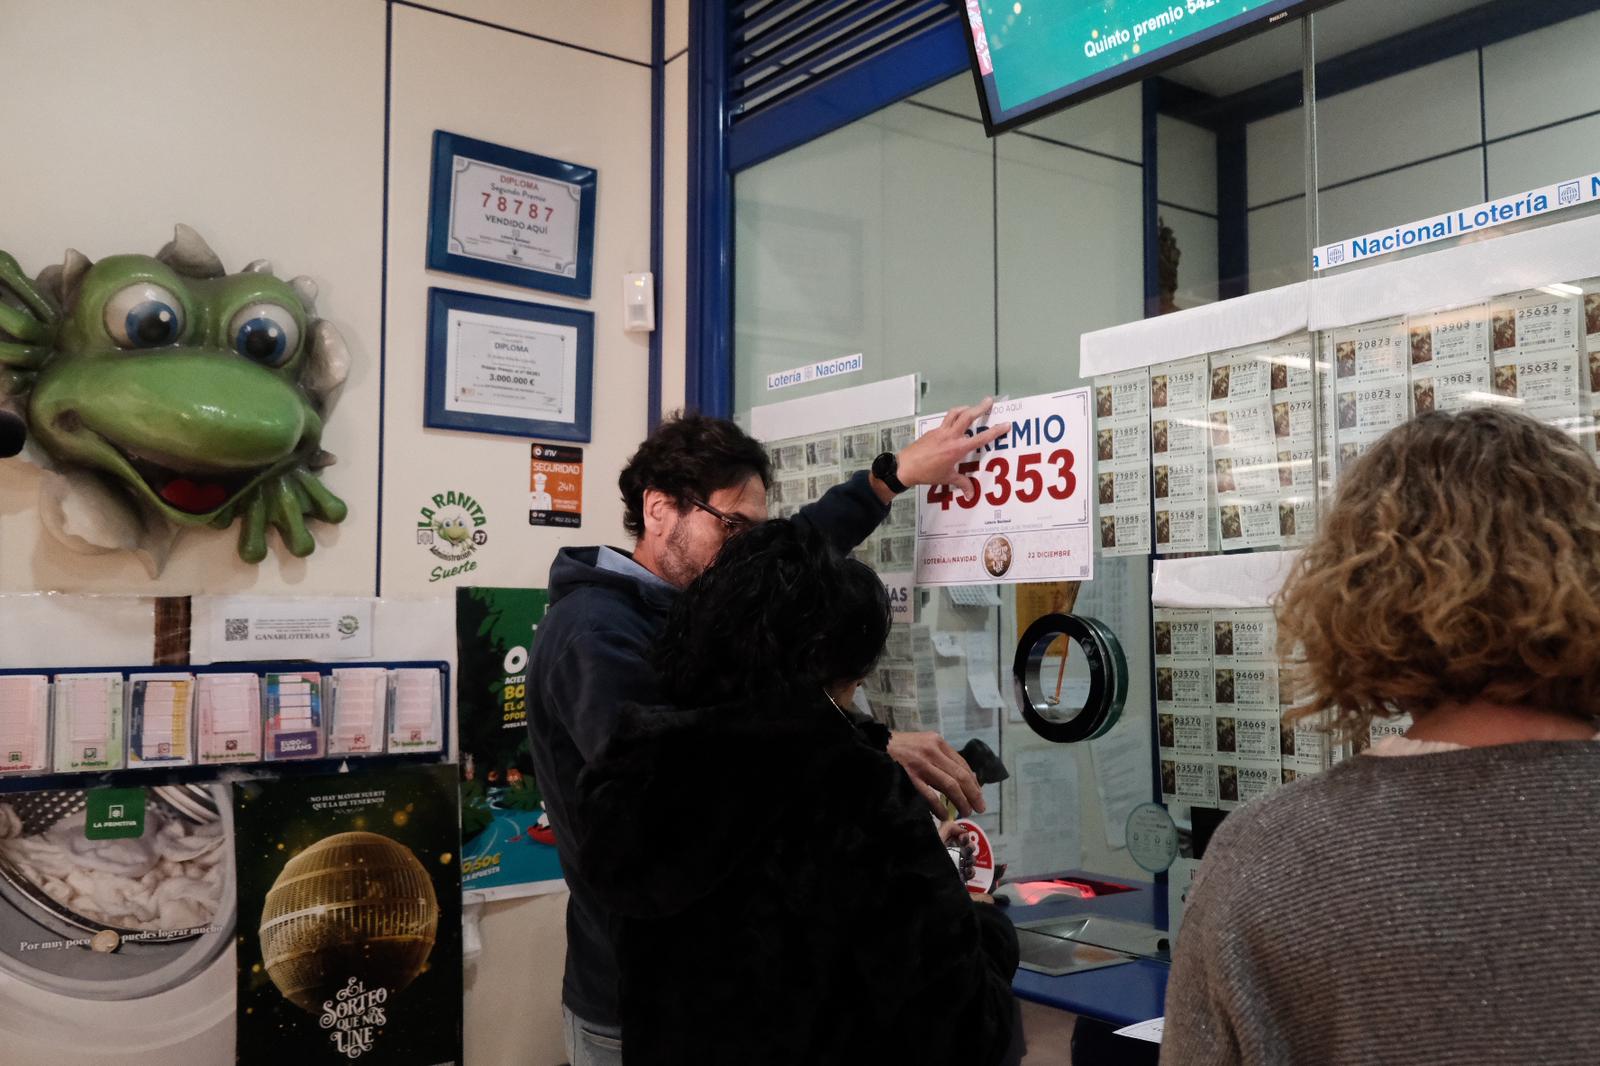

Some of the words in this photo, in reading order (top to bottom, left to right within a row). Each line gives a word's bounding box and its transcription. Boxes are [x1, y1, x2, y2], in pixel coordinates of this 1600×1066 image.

[1084, 26, 1130, 58] Quinto
[1132, 5, 1184, 40] premio
[491, 182, 520, 197] Segundo
[500, 175, 539, 191] DIPLOMA
[481, 192, 554, 222] 78787
[485, 214, 525, 230] VENDIDO
[1352, 216, 1452, 258] Nacional
[1458, 193, 1548, 231] Lotería
[1518, 305, 1558, 318] 25632
[494, 342, 529, 353] DIPLOMA
[1357, 338, 1390, 350] 20873
[768, 370, 801, 388] Lotería
[815, 355, 862, 377] Nacional
[1231, 362, 1258, 373] 11274
[1520, 361, 1558, 375] 25632
[489, 373, 528, 385] 3.000.000
[1358, 389, 1390, 401] 20873
[533, 461, 580, 475] SEGURIDAD
[926, 448, 1077, 511] 45353
[418, 507, 436, 528] LA
[431, 491, 487, 527] RANITA
[952, 555, 978, 564] NAVIDAD
[1036, 549, 1072, 558] DICIEMBRE
[429, 560, 477, 582] Suerte
[1172, 623, 1199, 631] 63570
[1173, 670, 1200, 678] 63570
[1236, 671, 1265, 680] 94669
[504, 684, 525, 700] BO
[1174, 717, 1201, 725] 63570
[1237, 720, 1266, 729] 94669
[1371, 726, 1404, 736] 97998
[1238, 769, 1268, 778] 94669
[361, 790, 386, 798] SUERTE
[312, 802, 327, 810] QUE
[121, 930, 156, 943] puedes
[158, 928, 189, 940] lograr
[20, 941, 40, 951] Por
[41, 941, 62, 951] muy
[65, 938, 91, 950] poco
[320, 987, 387, 1029] SORTEO
[336, 1016, 360, 1031] QUE
[362, 1006, 387, 1026] NOS
[330, 1026, 374, 1058] UNE
